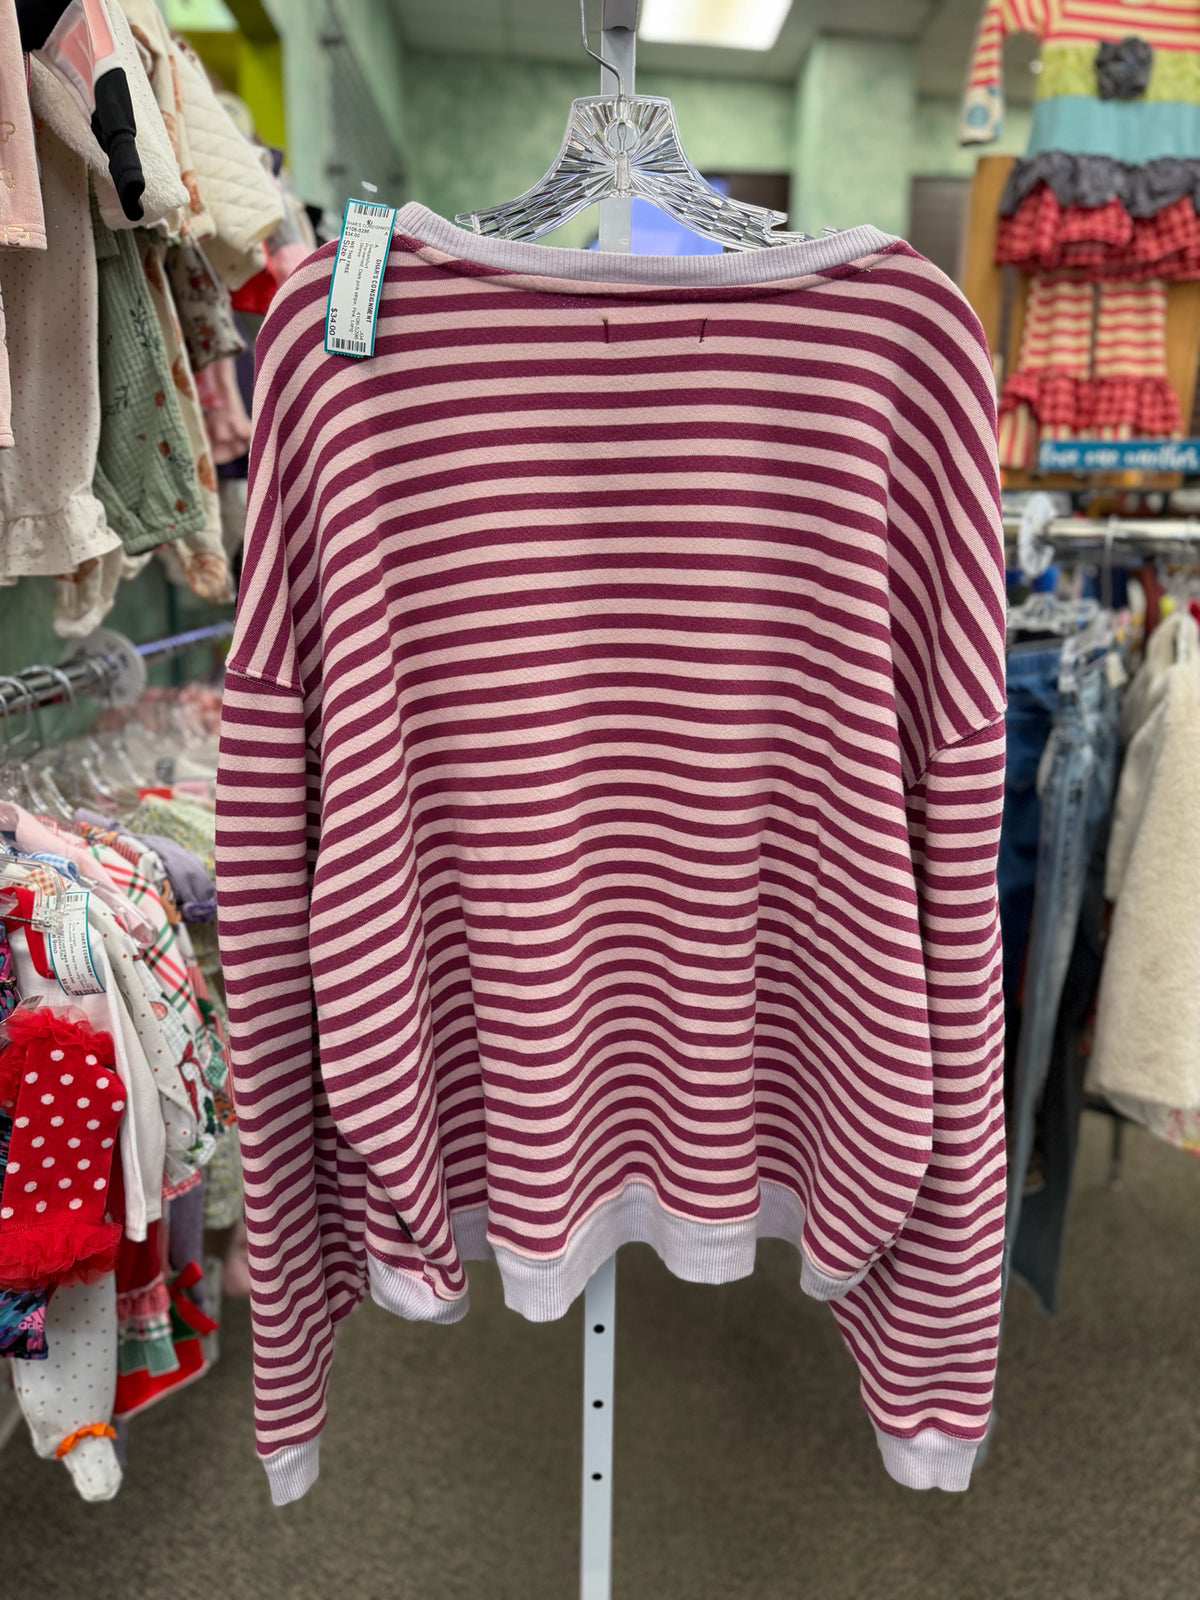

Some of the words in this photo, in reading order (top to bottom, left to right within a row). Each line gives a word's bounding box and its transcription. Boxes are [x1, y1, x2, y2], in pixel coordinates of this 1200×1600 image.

[340, 240, 351, 257] Size
[373, 259, 382, 279] SHAR'S
[366, 280, 378, 323] CONSIGNMENT
[329, 307, 338, 336] $34.00
